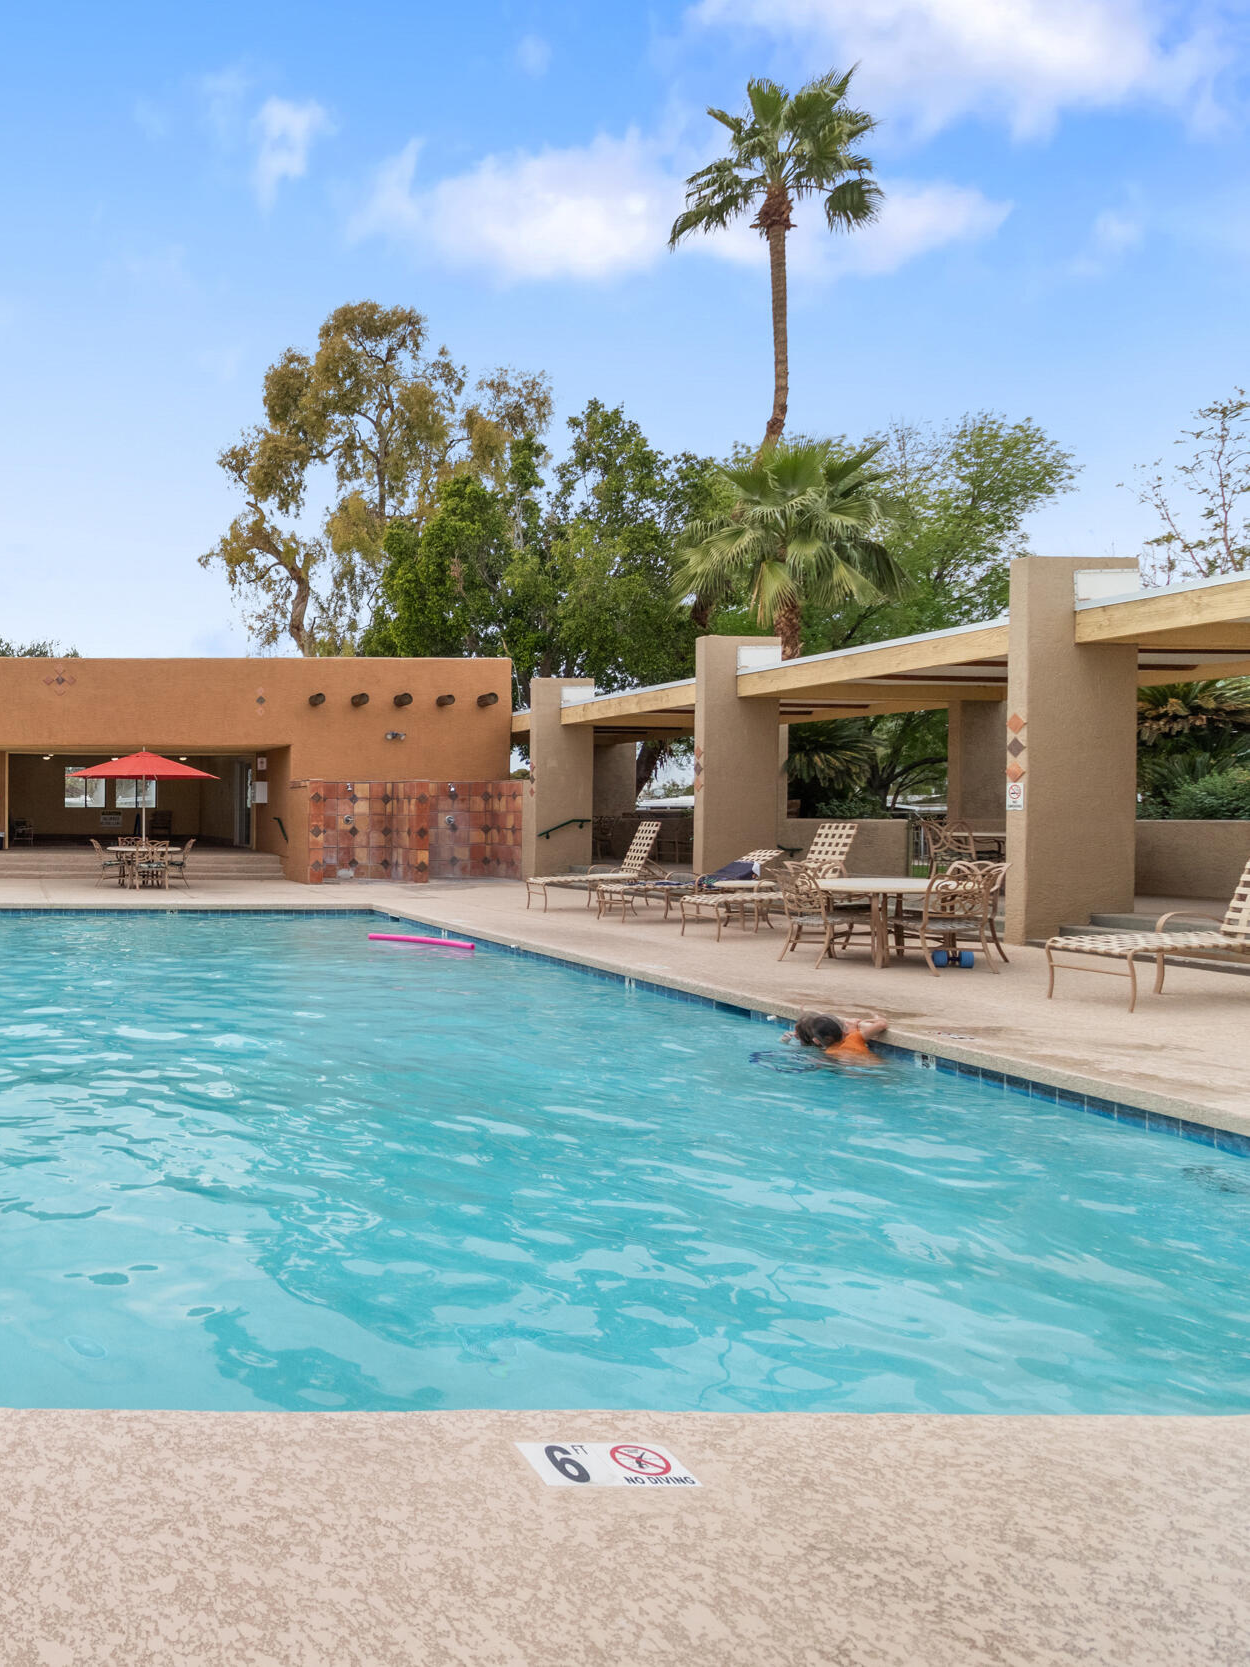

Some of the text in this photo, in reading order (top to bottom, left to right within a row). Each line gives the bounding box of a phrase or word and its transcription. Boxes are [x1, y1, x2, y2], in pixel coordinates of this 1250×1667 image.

[544, 1445, 591, 1483] 6 FT
[624, 1476, 696, 1485] NO DIVING
